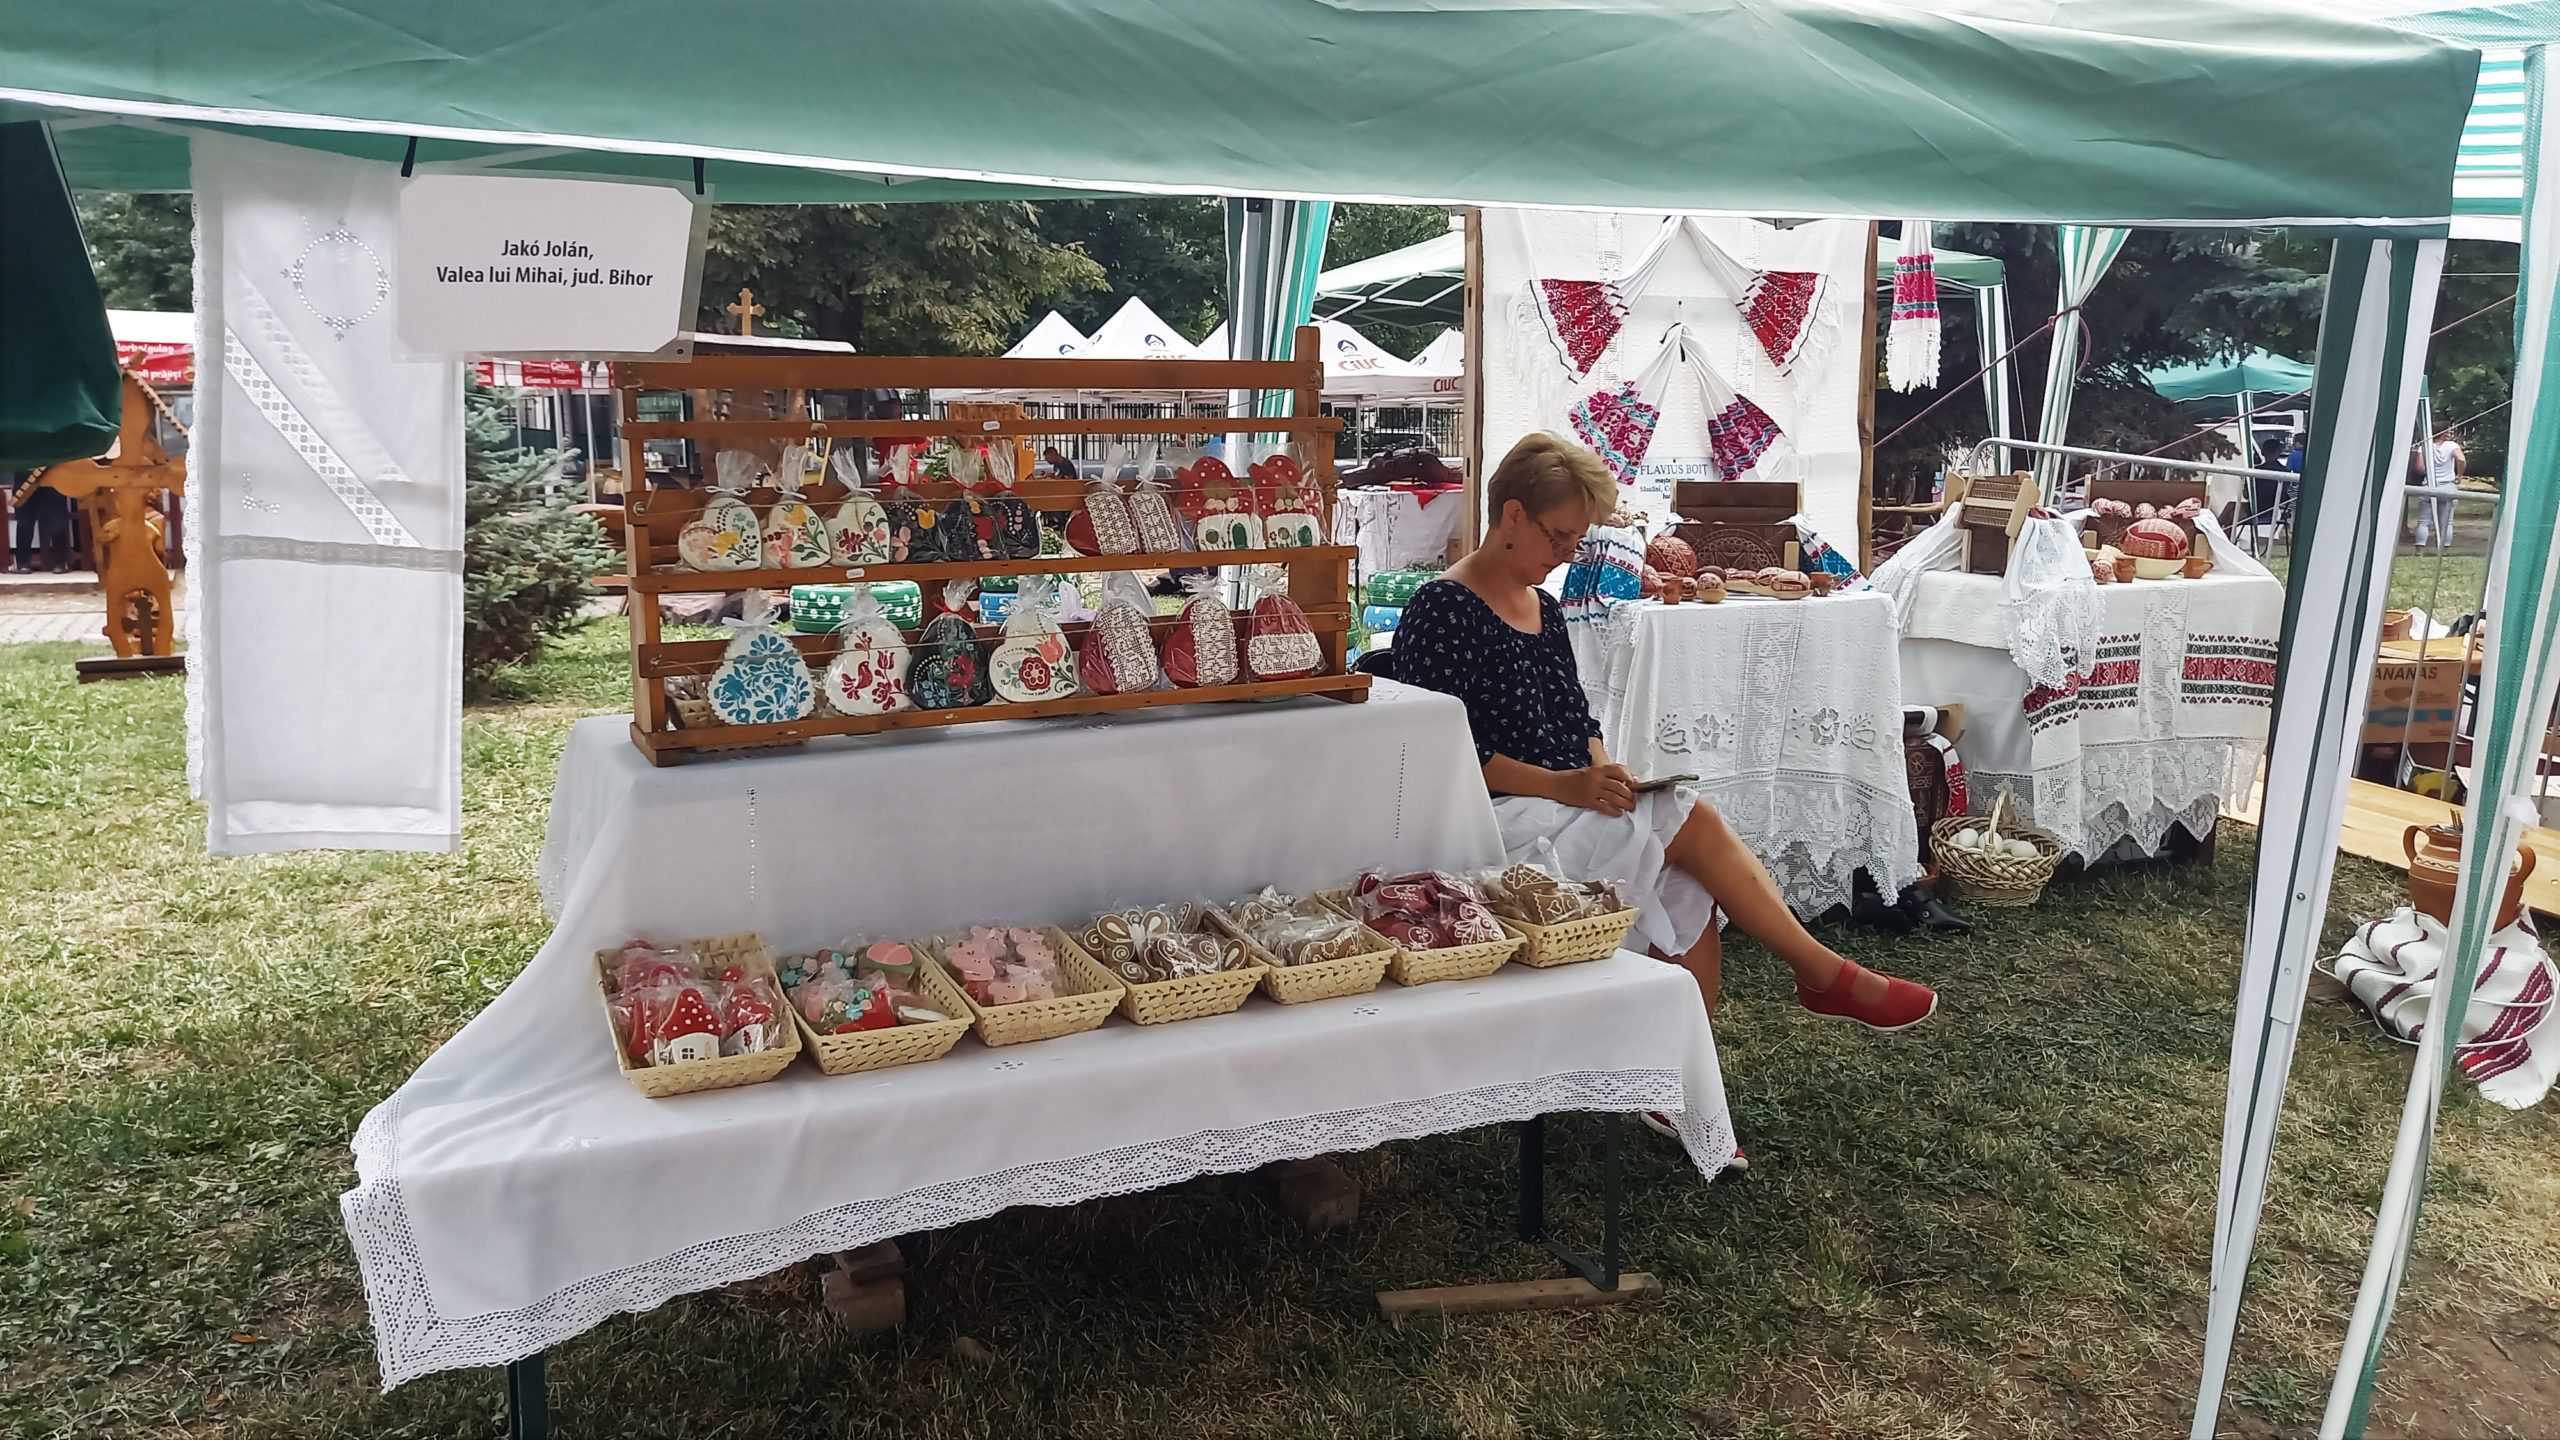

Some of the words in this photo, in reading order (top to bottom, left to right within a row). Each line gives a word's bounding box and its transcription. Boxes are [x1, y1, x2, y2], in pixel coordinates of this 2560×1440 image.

[501, 239, 540, 257] Jakó
[543, 241, 594, 260] Jolán,
[436, 266, 484, 283] Valea
[489, 266, 511, 283] lui
[515, 266, 568, 286] Mihai,
[571, 268, 604, 287] jud.
[608, 269, 653, 286] Bihor
[1640, 464, 1684, 475] FLAVIUS
